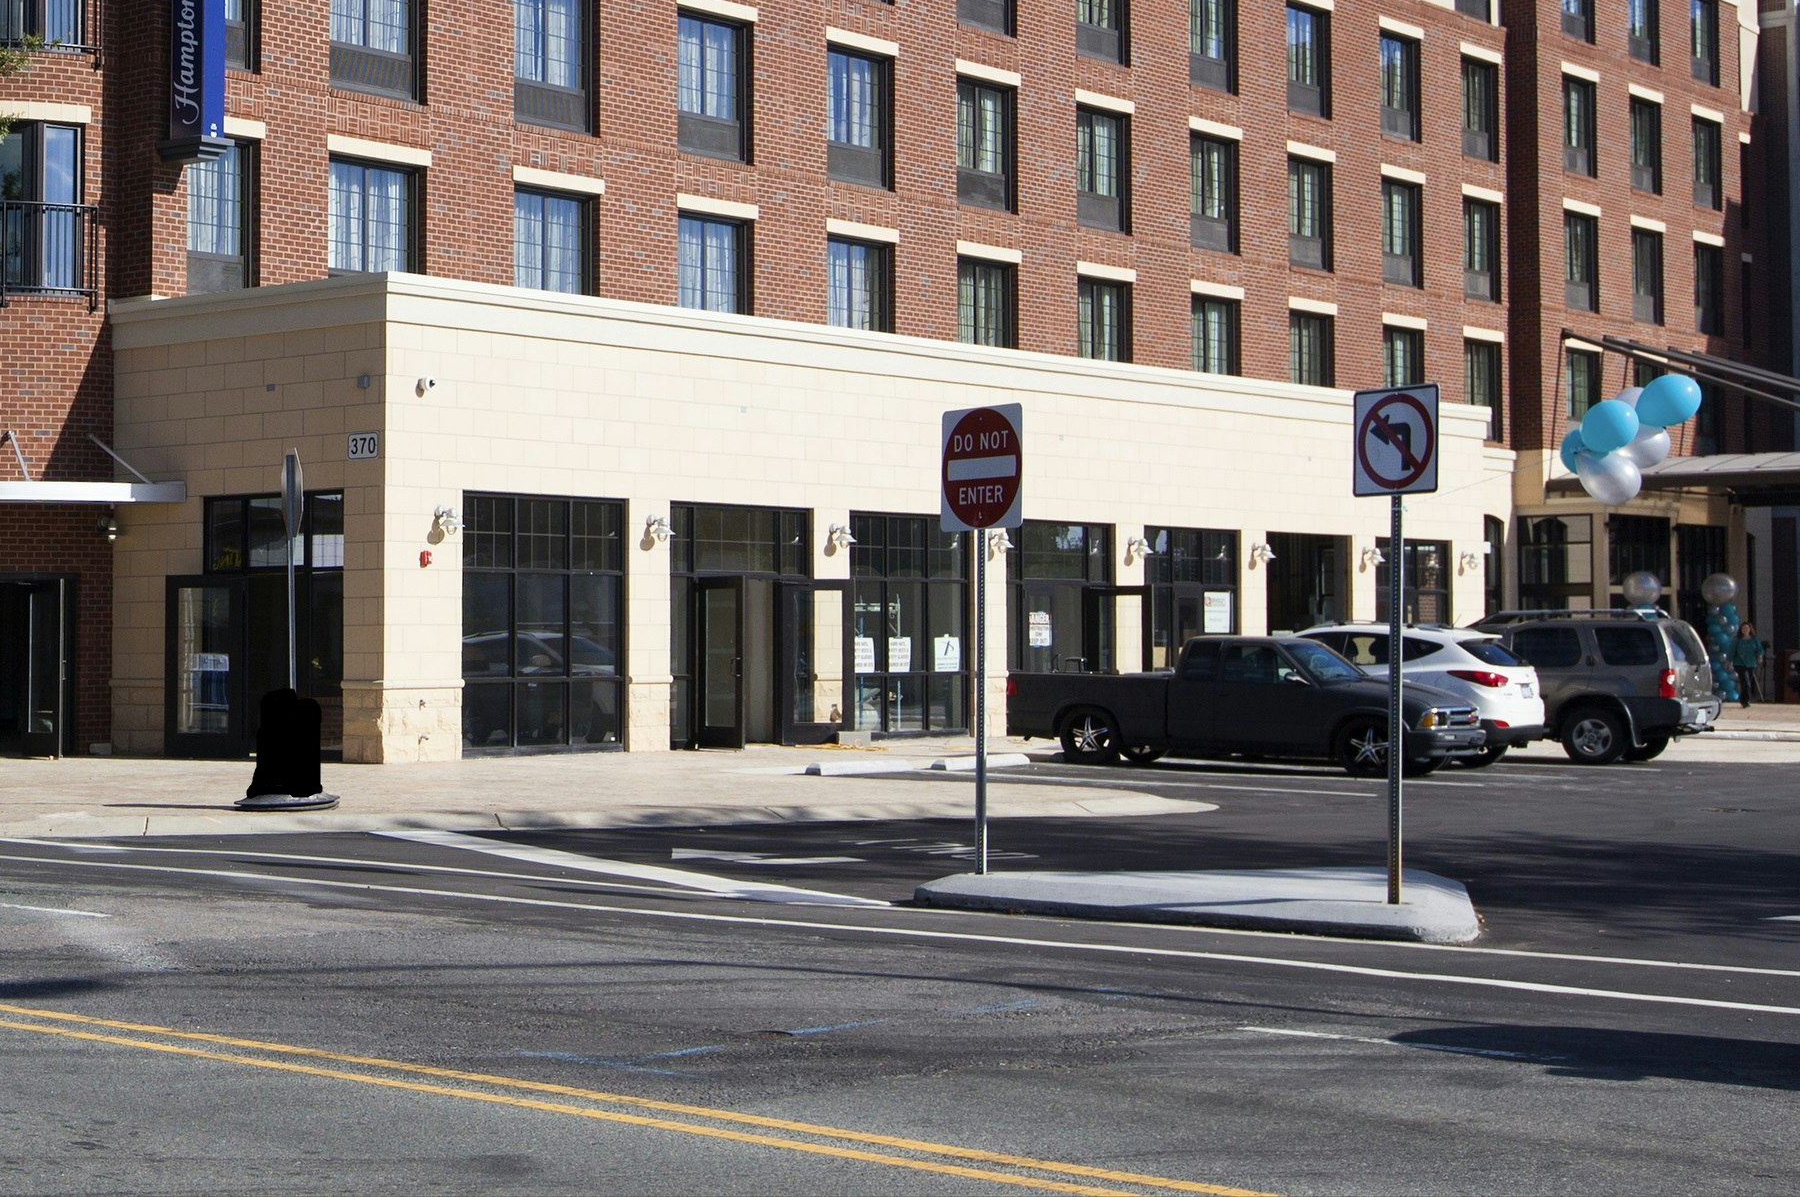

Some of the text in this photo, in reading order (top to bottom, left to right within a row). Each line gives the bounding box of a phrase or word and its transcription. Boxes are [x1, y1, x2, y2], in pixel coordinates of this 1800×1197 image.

[350, 437, 376, 455] 370
[954, 430, 1009, 452] DO NOT
[959, 484, 1003, 505] ENTER
